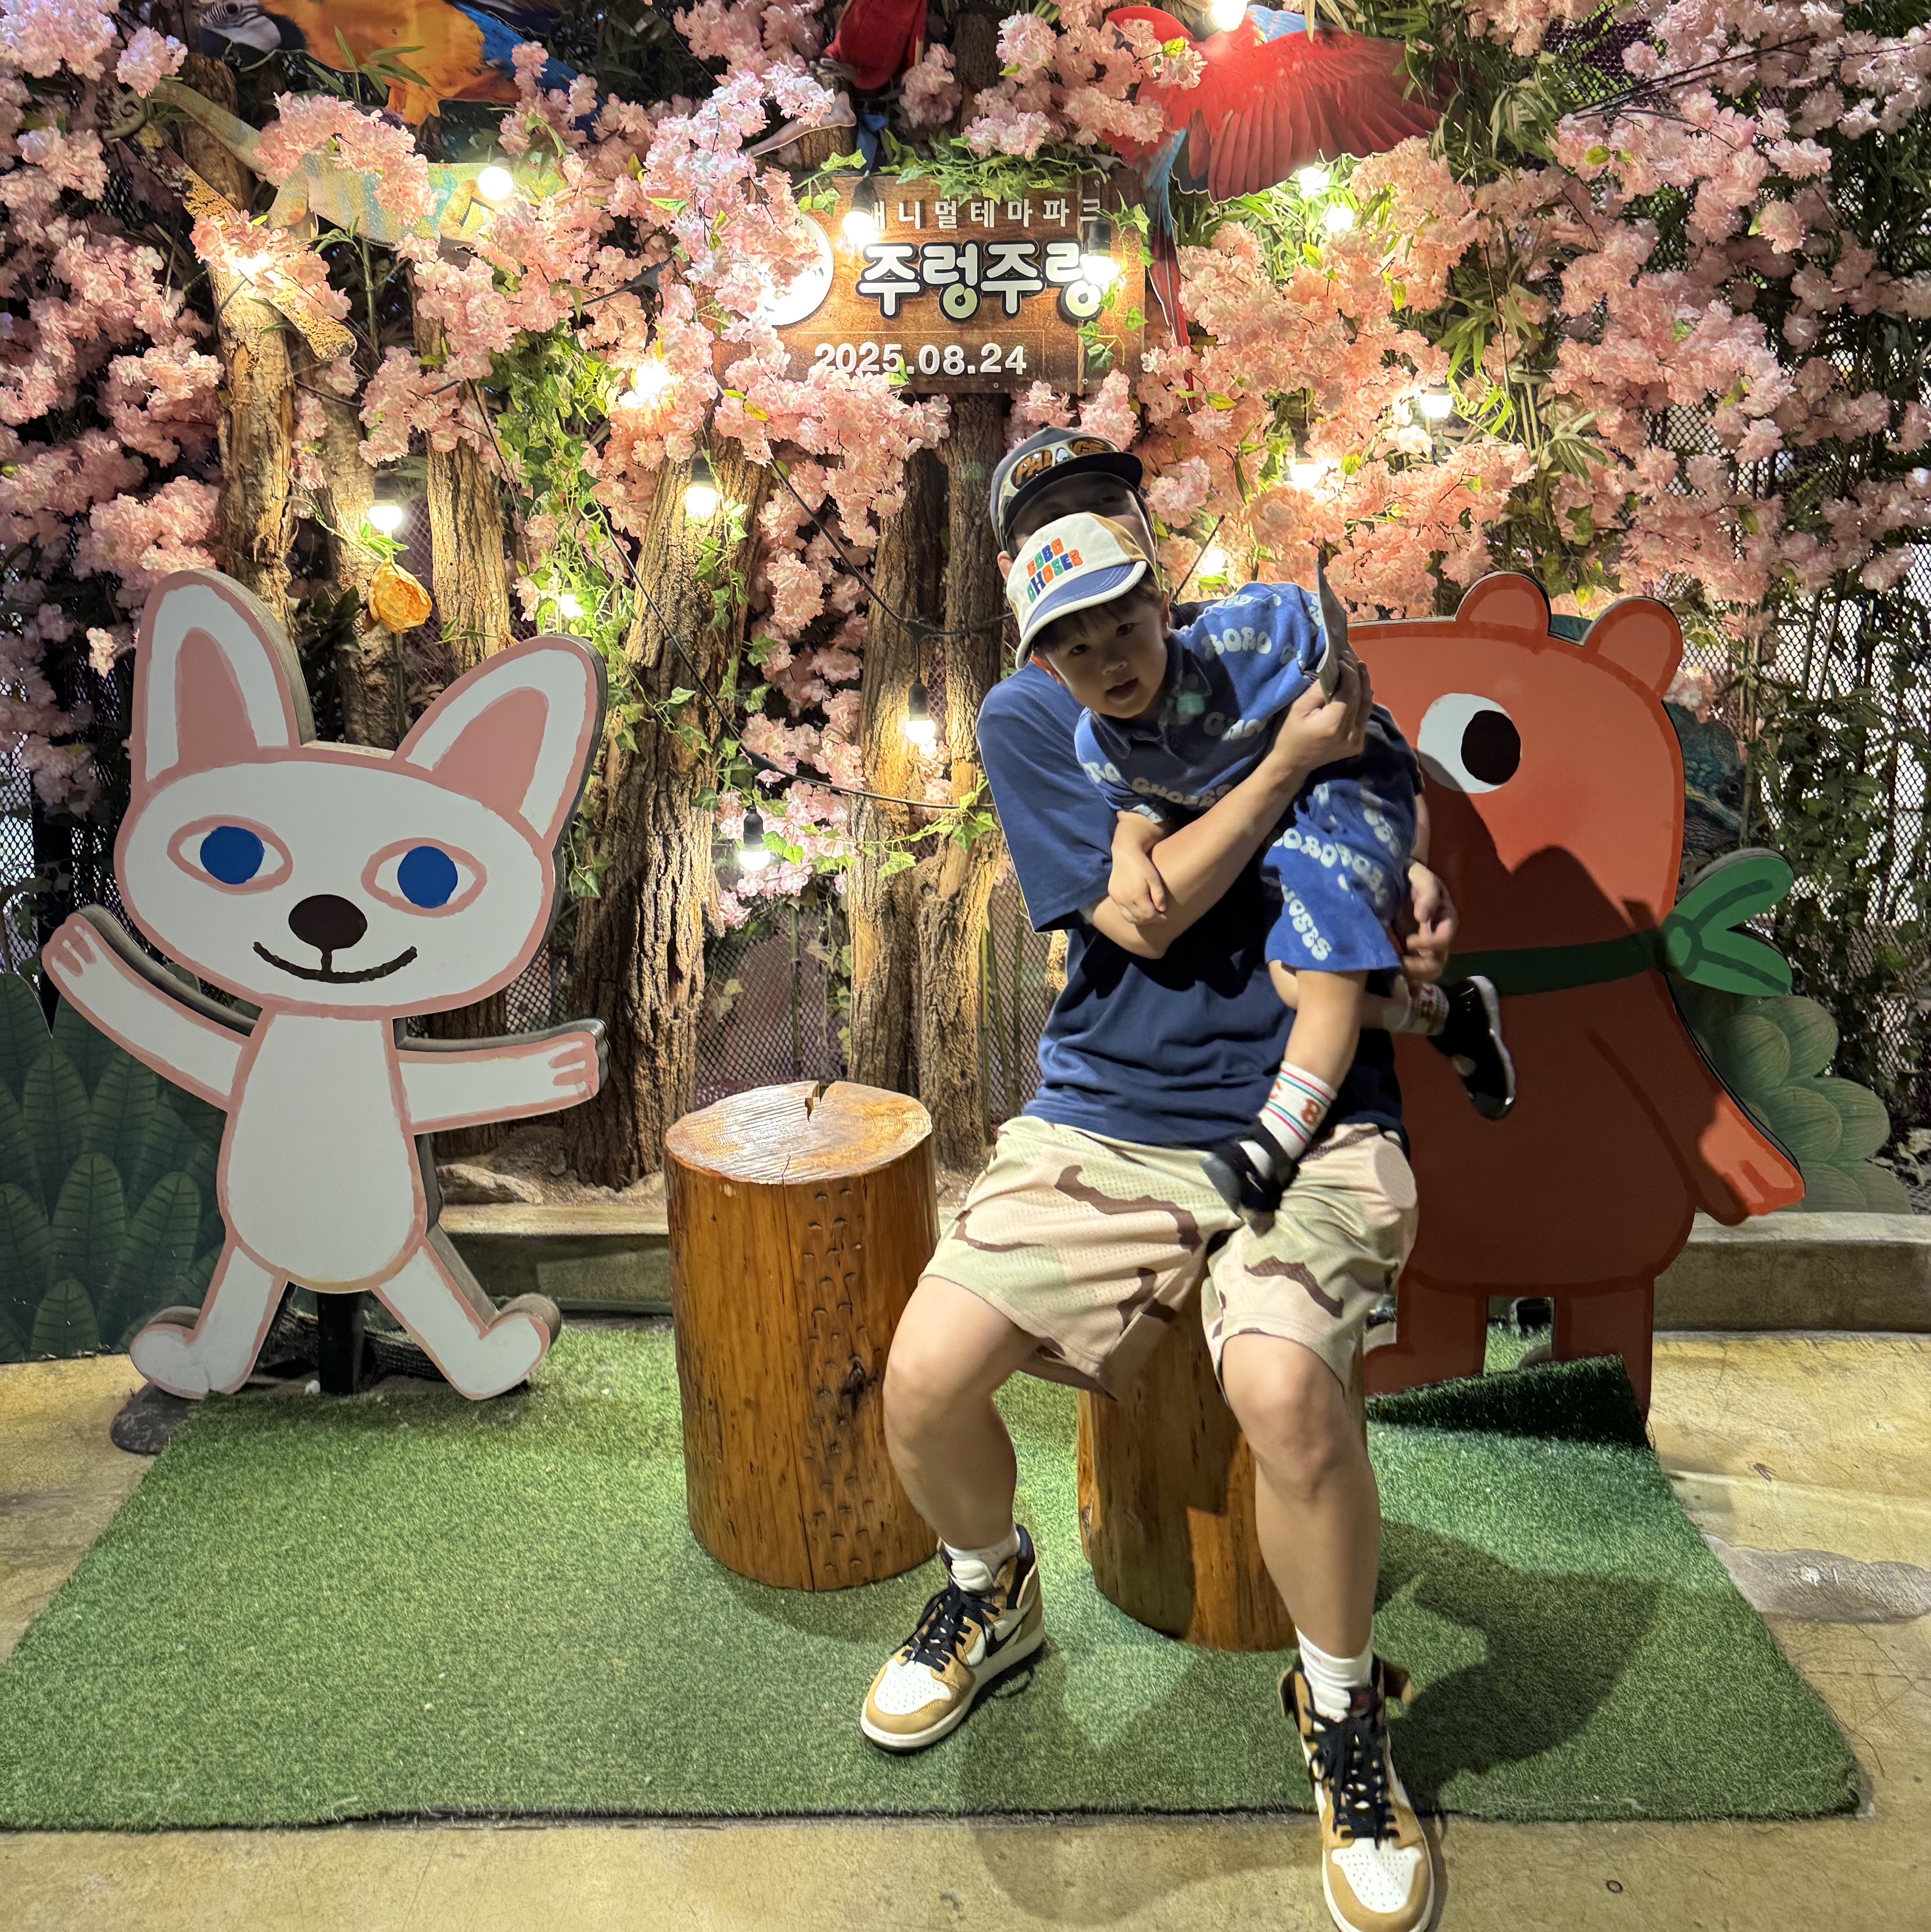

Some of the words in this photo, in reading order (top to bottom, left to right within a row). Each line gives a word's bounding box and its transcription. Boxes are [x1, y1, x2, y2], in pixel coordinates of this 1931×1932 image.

[856, 239, 1105, 321] 주렁주렁
[815, 342, 1027, 375] 2025.08.24
[1272, 827, 1337, 868] OBO
